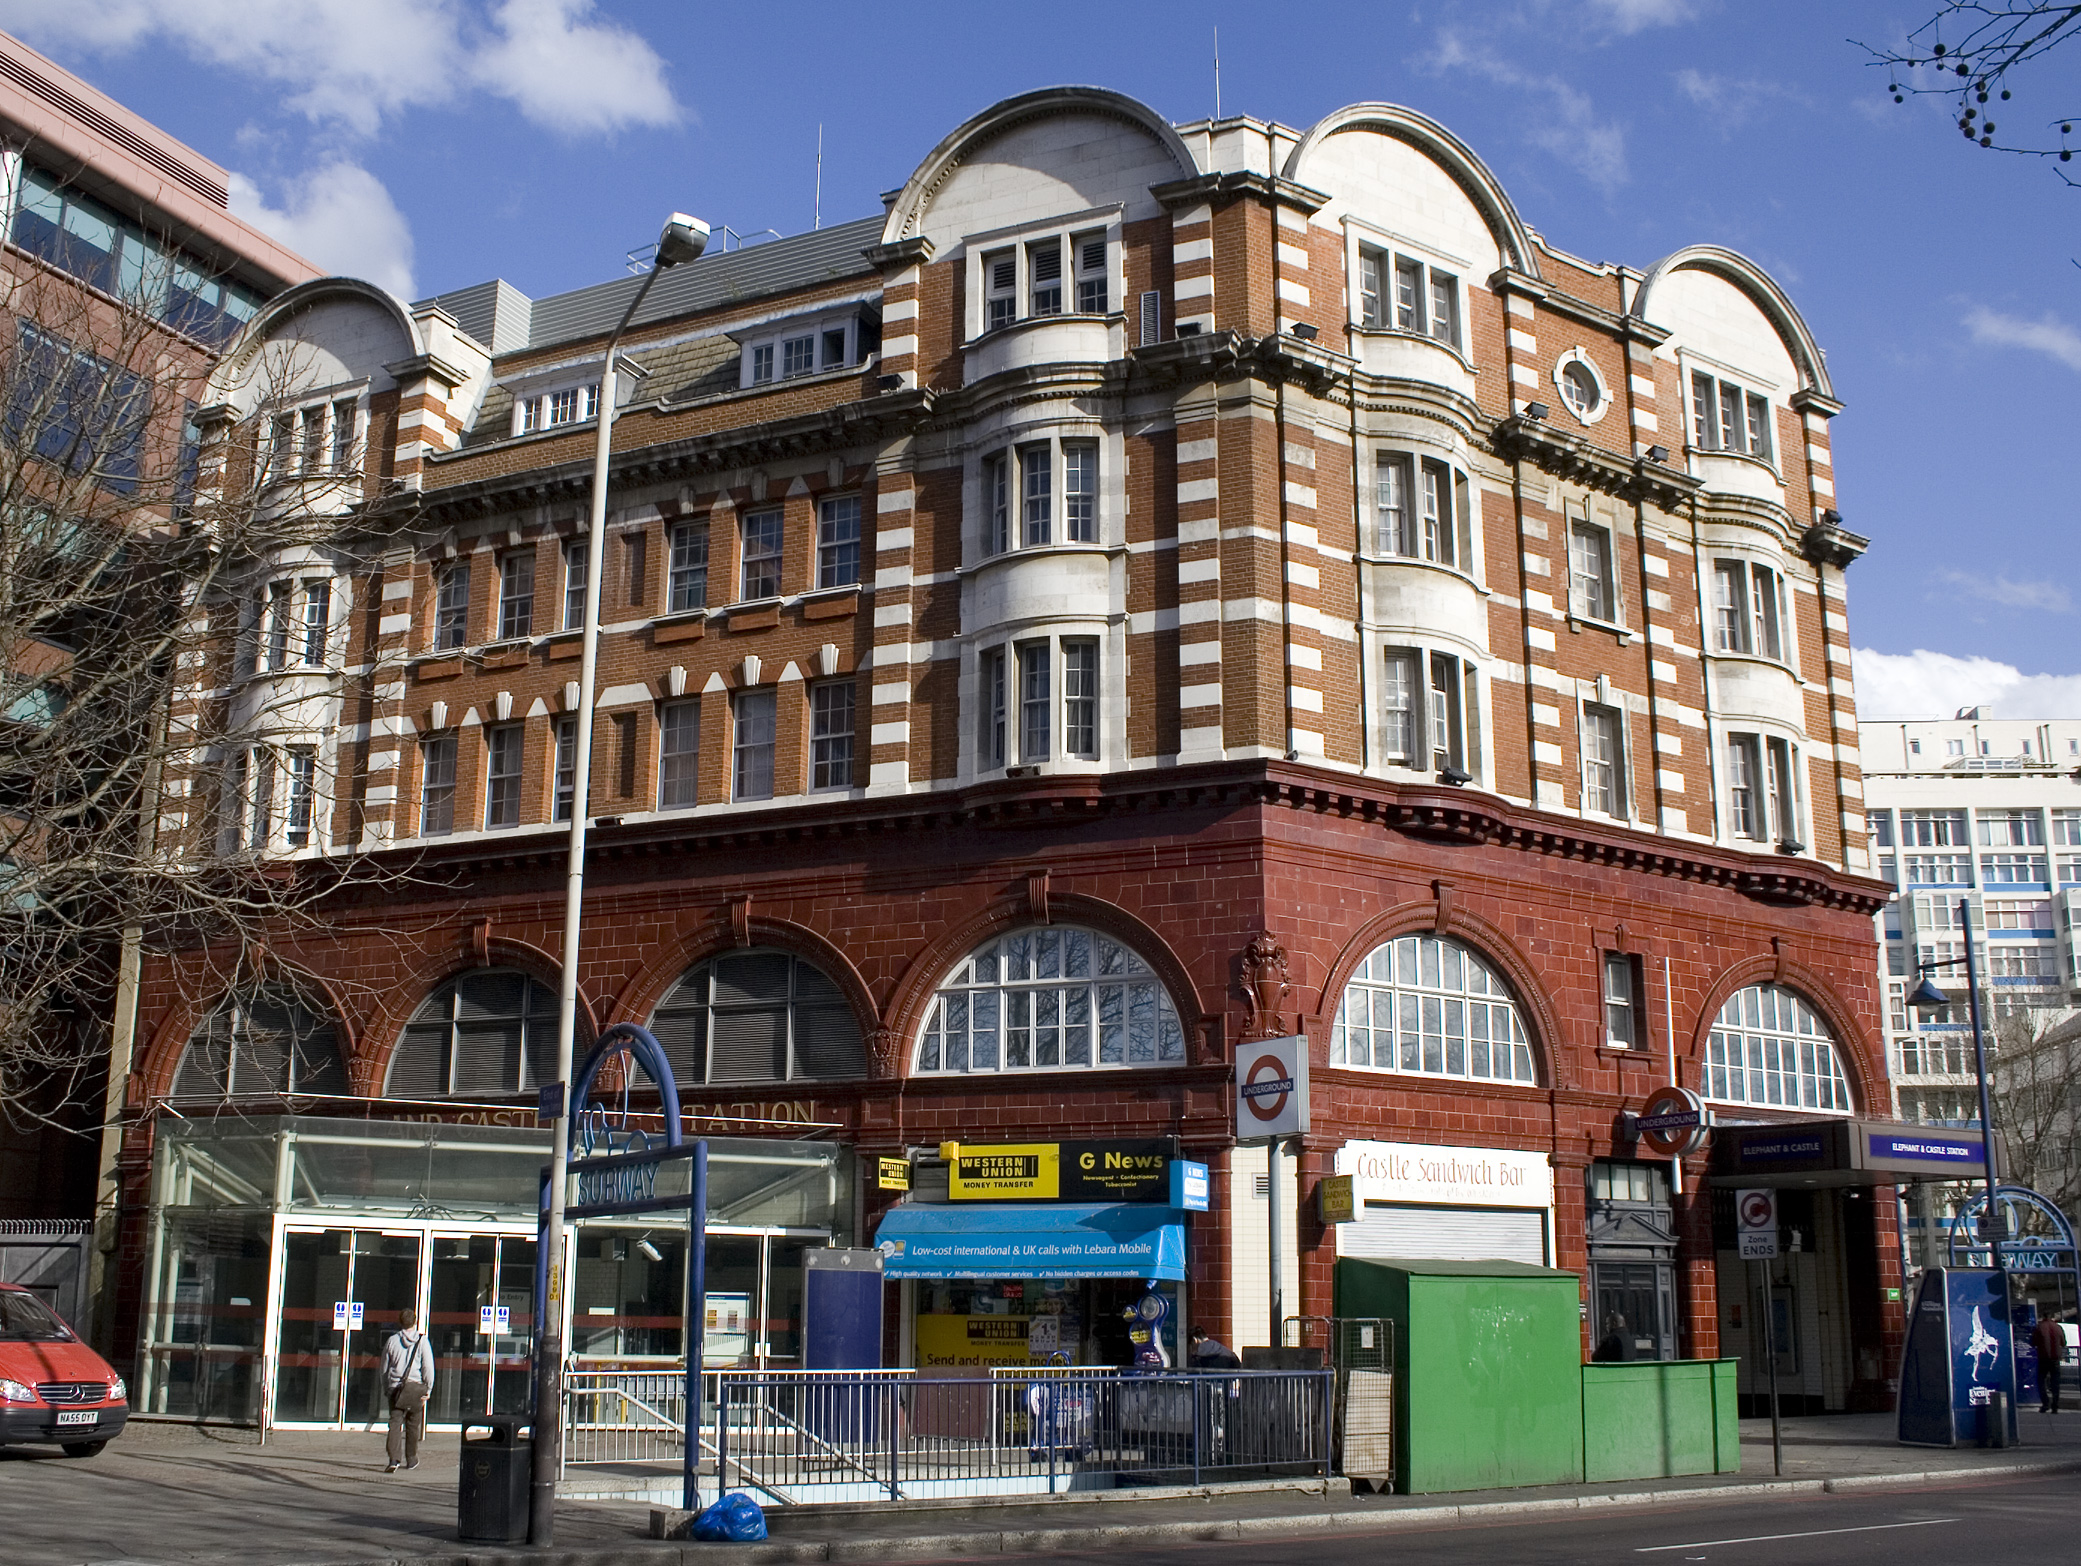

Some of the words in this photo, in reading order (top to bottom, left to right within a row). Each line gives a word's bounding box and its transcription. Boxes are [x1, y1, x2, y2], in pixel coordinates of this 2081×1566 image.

[1244, 1082, 1292, 1096] UNDERGROUND
[1637, 1114, 1698, 1128] UNDERGROUND
[1743, 1145, 1781, 1155] ELEPHANT
[1782, 1144, 1790, 1153] &
[1790, 1142, 1820, 1152] CASTLE
[1892, 1143, 1919, 1153] ELEPHANT
[1926, 1146, 1946, 1154] CASTLE
[1947, 1147, 1969, 1156] STATION
[961, 1157, 1023, 1168] WESTERN
[1080, 1152, 1095, 1170] G
[1105, 1152, 1163, 1169] News
[981, 1167, 1023, 1177] UNION
[1358, 1153, 1410, 1181] Castle
[1417, 1158, 1493, 1185] Sandwich
[1500, 1162, 1527, 1186] Bar
[579, 1161, 661, 1206] SUBWAY
[1328, 1180, 1348, 1189] CASTLE
[1331, 1200, 1345, 1209] BAR
[912, 1245, 952, 1256] Low-cost
[953, 1244, 1010, 1256] international
[1013, 1245, 1020, 1255] &
[1022, 1245, 1037, 1255] UK
[1038, 1244, 1059, 1255] calls
[1062, 1244, 1081, 1255] with
[1084, 1244, 1116, 1255] Lebara
[1118, 1243, 1151, 1254] Mobile
[1743, 1245, 1774, 1255] ENDS
[1074, 1270, 1095, 1278] charges
[969, 1321, 1018, 1330] WESTERN
[985, 1329, 1018, 1338] UNION
[927, 1354, 955, 1366] Send
[958, 1354, 980, 1366] and
[984, 1355, 1026, 1367] receive
[61, 1413, 81, 1423] NA55
